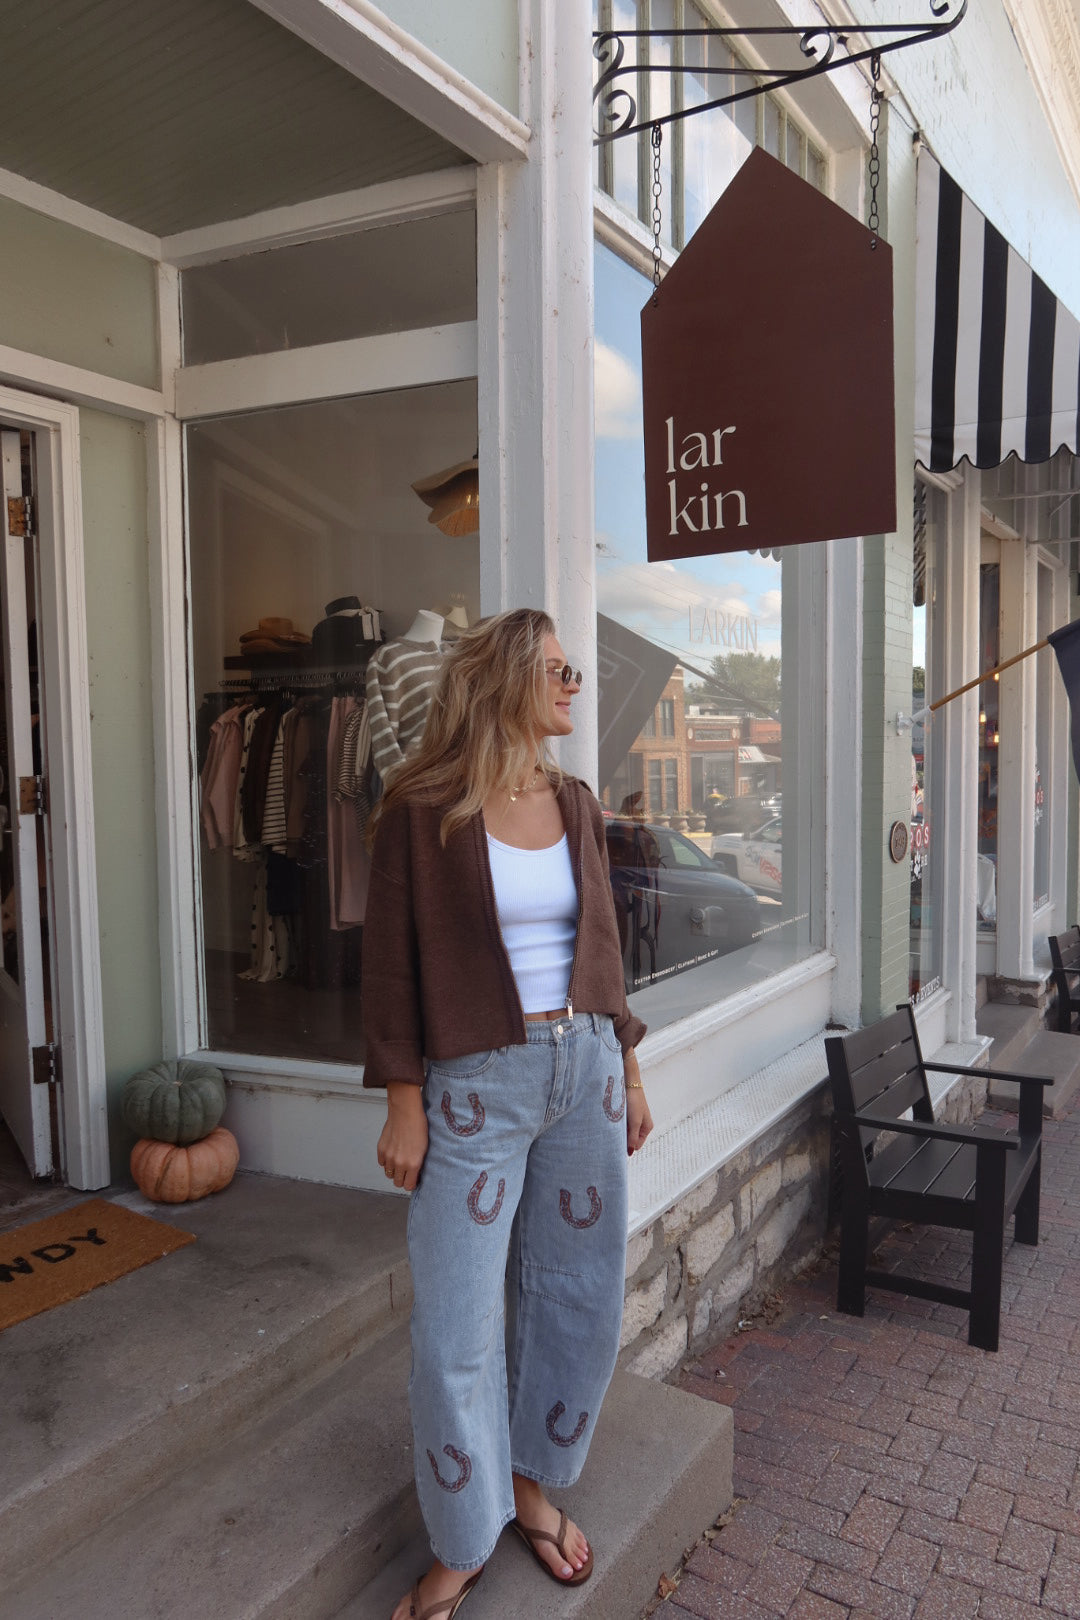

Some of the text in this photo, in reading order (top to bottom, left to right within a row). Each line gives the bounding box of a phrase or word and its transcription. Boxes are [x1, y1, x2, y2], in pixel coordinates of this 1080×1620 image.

[665, 416, 737, 474] lar
[667, 478, 750, 536] kin
[688, 604, 759, 653] LARKIN
